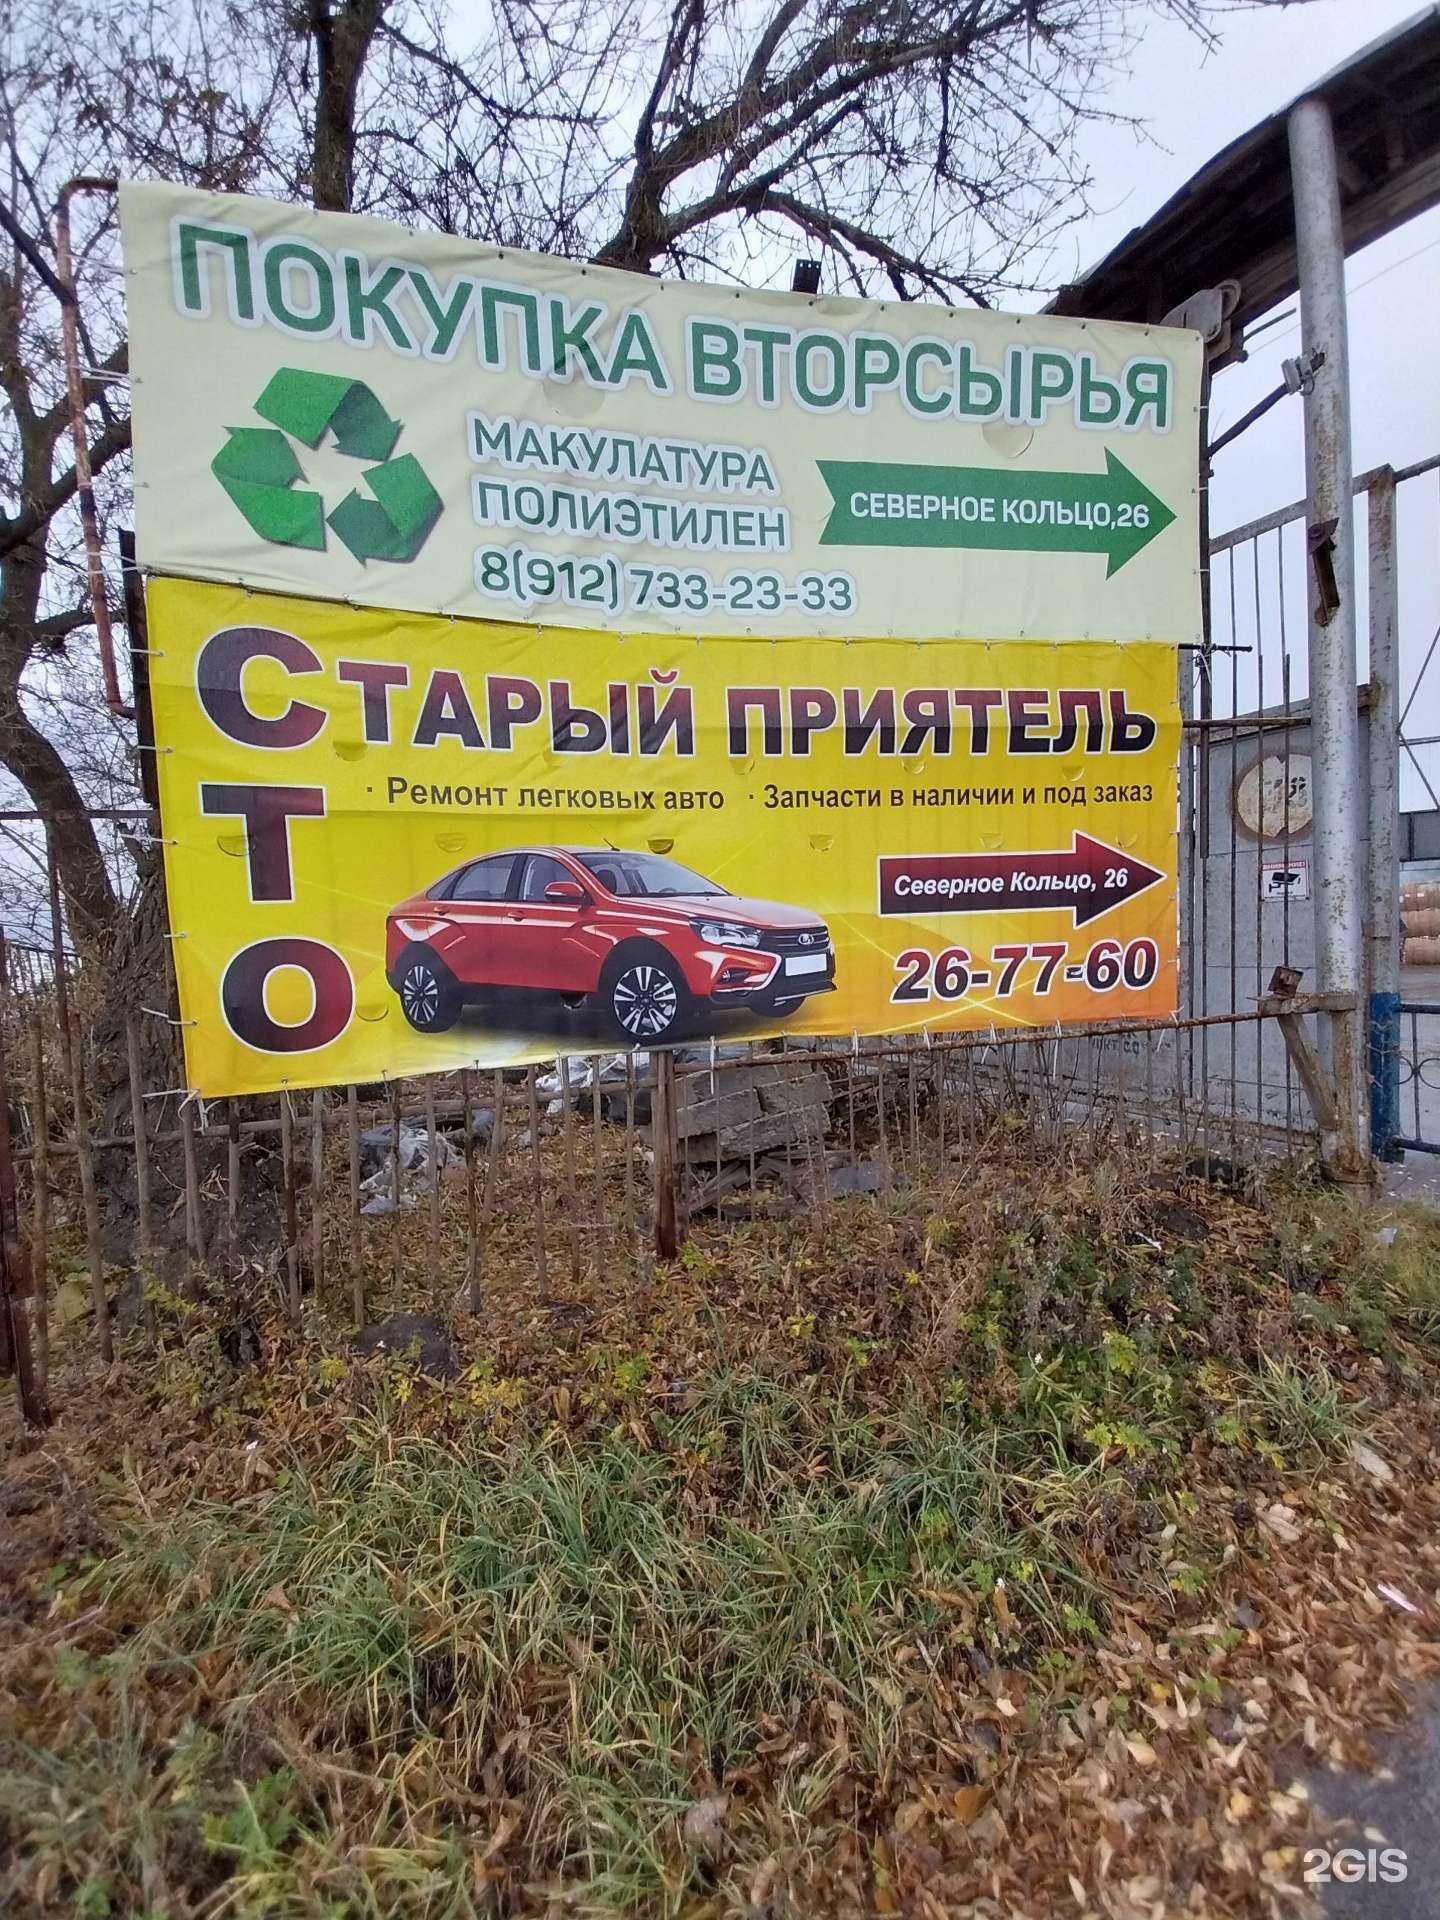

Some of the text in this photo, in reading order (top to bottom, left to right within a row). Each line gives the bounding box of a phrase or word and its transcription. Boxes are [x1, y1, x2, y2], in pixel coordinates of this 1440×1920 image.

[179, 223, 1168, 428] ПОКУПКА ВТОРСЫРЬЯ
[473, 417, 775, 491] МАКУЛАТУРА
[478, 481, 786, 547] ПОЛИЭТИЛЕН
[850, 491, 1150, 530] СЕВЕРНОЕ КОЛЬЦО,26
[479, 550, 853, 610] 8(912) 733-23-33
[726, 687, 1158, 756] ПРИЯТЕЛЬ
[387, 776, 725, 810] Ремонт легковых авто
[763, 783, 1153, 809] Запчасти в наличии и под заказ
[893, 867, 1129, 898] Северное Кольцо, 26
[890, 937, 1159, 1003] 26-77-60
